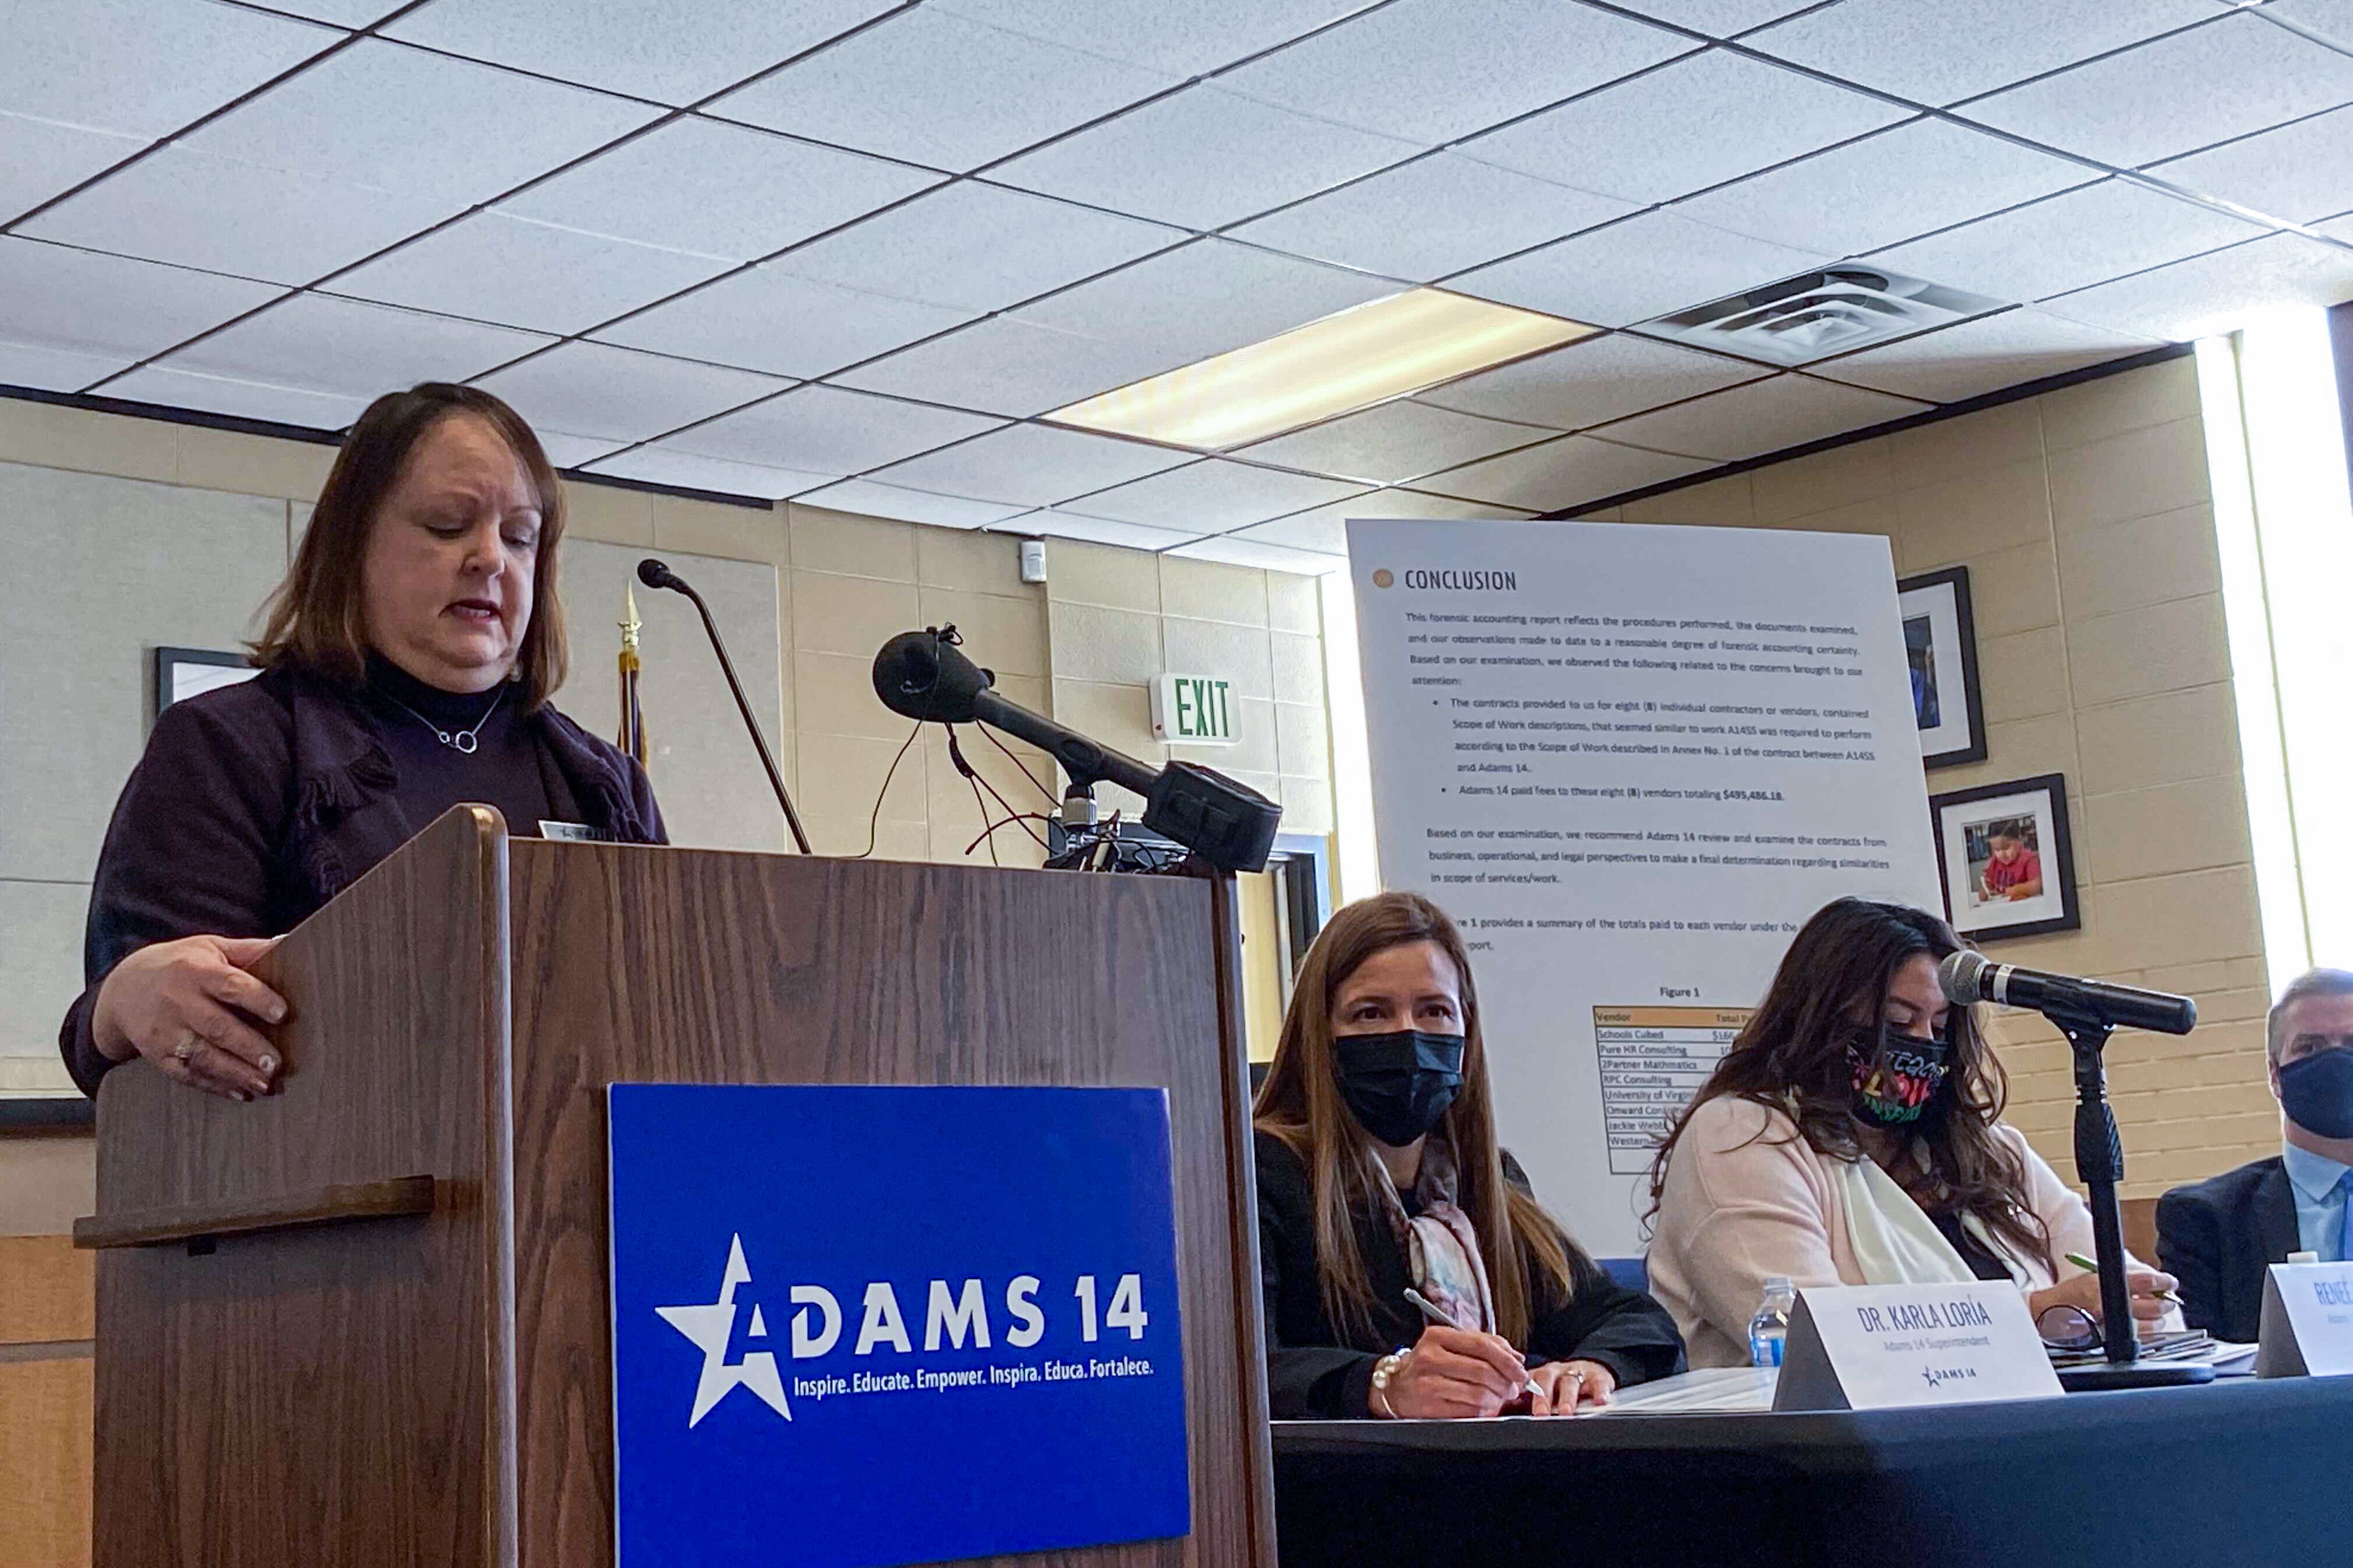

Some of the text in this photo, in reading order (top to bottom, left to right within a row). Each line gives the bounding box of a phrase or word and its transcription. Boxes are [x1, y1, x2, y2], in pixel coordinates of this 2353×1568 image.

[1405, 570, 1517, 590] CONCLUSION
[1405, 613, 1427, 622] This
[1430, 614, 1469, 622] forensic
[1473, 616, 1527, 625] accounting
[1530, 617, 1561, 625] report
[1564, 616, 1599, 625] reflects
[1602, 618, 1618, 626] the
[1736, 622, 1752, 630] the
[1755, 623, 1807, 632] documents
[1408, 635, 1428, 643] and
[1452, 636, 1515, 644] observations
[1590, 638, 1600, 646] to
[1615, 639, 1667, 648] reasonable
[1672, 640, 1705, 650] degree
[1708, 640, 1717, 649] of
[1721, 641, 1758, 650] forensic
[1411, 655, 1439, 663] Based
[1565, 658, 1609, 667] observed
[1613, 659, 1629, 668] the
[1632, 659, 1677, 670] following
[1680, 661, 1714, 670] related
[1730, 663, 1746, 671] the
[1834, 667, 1843, 675] to
[1175, 679, 1229, 737] EXIT
[1450, 699, 1470, 708] The
[1473, 700, 1519, 708] contracts
[1522, 700, 1565, 709] provided
[1597, 700, 1612, 710] for
[1615, 702, 1639, 712] eight
[1644, 702, 1656, 712] (8)
[1661, 703, 1705, 712] individual
[1709, 706, 1763, 714] contractors
[1823, 710, 1868, 718] contained
[1485, 720, 1495, 729] of
[1498, 720, 1525, 729] Work
[1592, 723, 1612, 731] that
[1655, 724, 1685, 732] similar
[1779, 729, 1818, 738] required
[1834, 730, 1871, 739] perform
[1455, 742, 1503, 752] according
[1519, 742, 1535, 751] the
[1538, 742, 1566, 752] Scope
[1570, 743, 1579, 752] of
[1582, 743, 1609, 752] Work
[1611, 744, 1657, 753] described
[1732, 746, 1741, 756] of
[1744, 748, 1759, 756] the
[1803, 750, 1843, 759] between
[1478, 764, 1512, 772] Adams
[1497, 786, 1508, 795] 14
[1535, 786, 1556, 795] fees
[1601, 789, 1624, 798] eight
[1627, 788, 1639, 799] (8)
[1642, 789, 1682, 798] vendors
[1684, 790, 1721, 800] totaling
[1427, 829, 1457, 838] Based
[1584, 832, 1642, 840] recommend
[1647, 832, 1679, 841] Adams
[1683, 832, 1694, 842] 14
[1734, 834, 1751, 843] and
[1755, 836, 1794, 844] examine
[1798, 836, 1814, 845] the
[1817, 838, 1861, 846] contracts
[1864, 838, 1886, 846] from
[1541, 852, 1559, 860] and
[1561, 852, 1584, 863] legal
[1587, 854, 1647, 863] perspectives
[1662, 855, 1688, 863] make
[1699, 855, 1719, 864] final
[1722, 856, 1790, 865] determination
[1839, 859, 1889, 869] similarities
[1444, 875, 1472, 883] scope
[1475, 872, 1485, 882] of
[1471, 918, 1478, 927] 1
[1481, 919, 1523, 929] provides
[1536, 920, 1582, 929] summary
[1586, 919, 1595, 928] of
[1599, 920, 1615, 929] the
[1619, 920, 1645, 929] totals
[1649, 920, 1670, 930] paid
[1687, 922, 1710, 930] each
[1713, 922, 1747, 930] vendor
[1750, 923, 1779, 932] under
[1782, 923, 1797, 933] the
[1660, 987, 1699, 998] Figure 1
[1596, 1013, 1631, 1022] Vendor
[1716, 1014, 1739, 1022] Total
[1598, 1030, 1664, 1039] Schools Cubed
[1600, 1045, 1687, 1056] Pure HR Consulting
[1624, 1075, 1672, 1086] Consulting
[1605, 1090, 1663, 1102] University of
[1607, 1106, 1643, 1115] Onward
[1608, 1121, 1635, 1130] Jackie
[1075, 1273, 1148, 1342] 14
[1857, 1294, 1993, 1332] DR. KARLA LORÍA
[794, 1356, 1154, 1400] Inspire. Educate. Empower. Inspira. Educa. Fortalece.
[1966, 1367, 1977, 1377] 14
